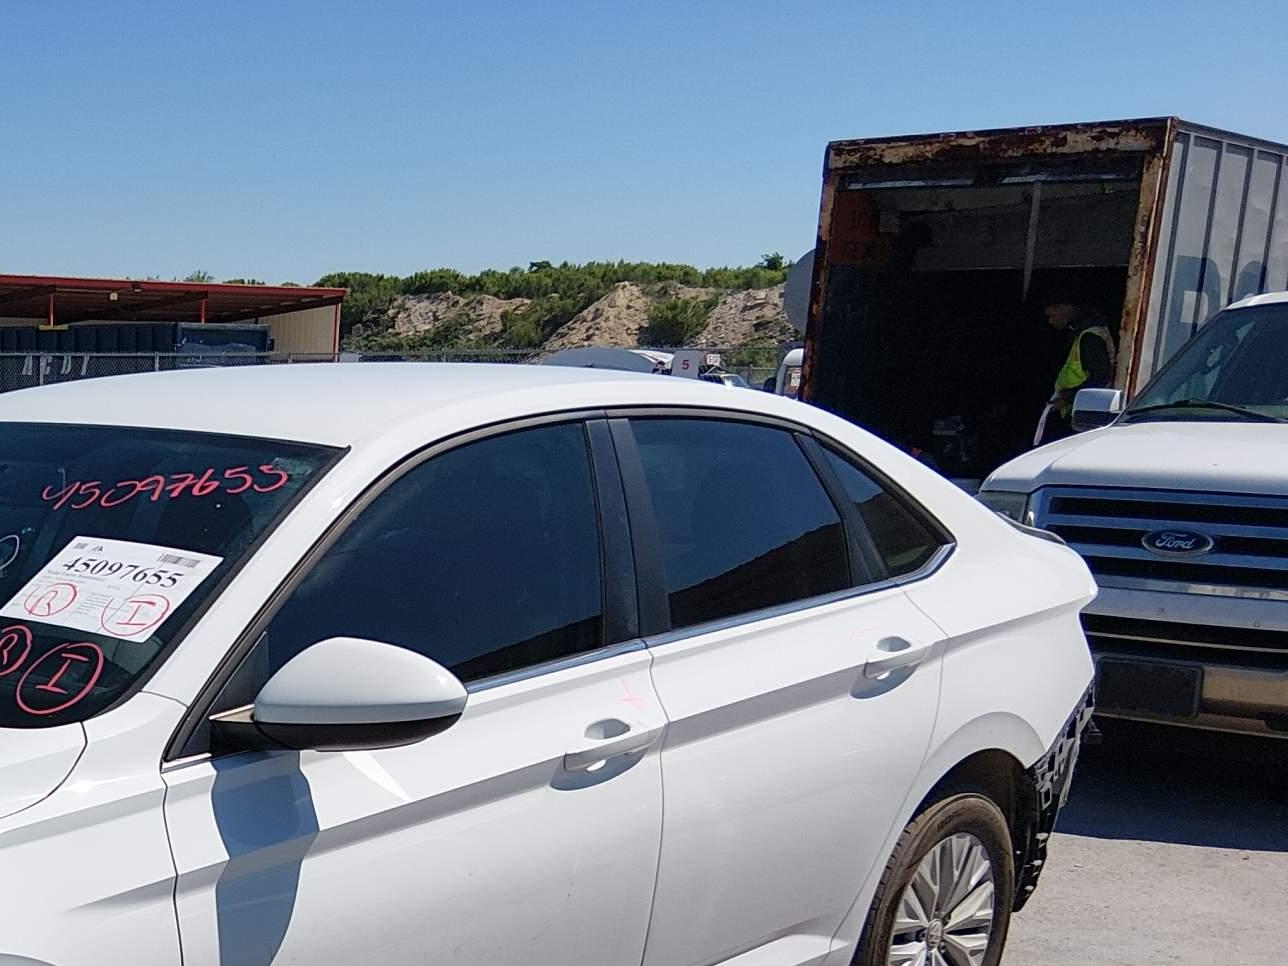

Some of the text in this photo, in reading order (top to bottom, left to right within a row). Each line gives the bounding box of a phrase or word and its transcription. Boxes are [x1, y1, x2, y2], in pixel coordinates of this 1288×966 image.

[681, 359, 690, 370] 5
[42, 464, 289, 511] 45097655
[1155, 532, 1197, 549] Ford
[62, 556, 185, 588] 45097655
